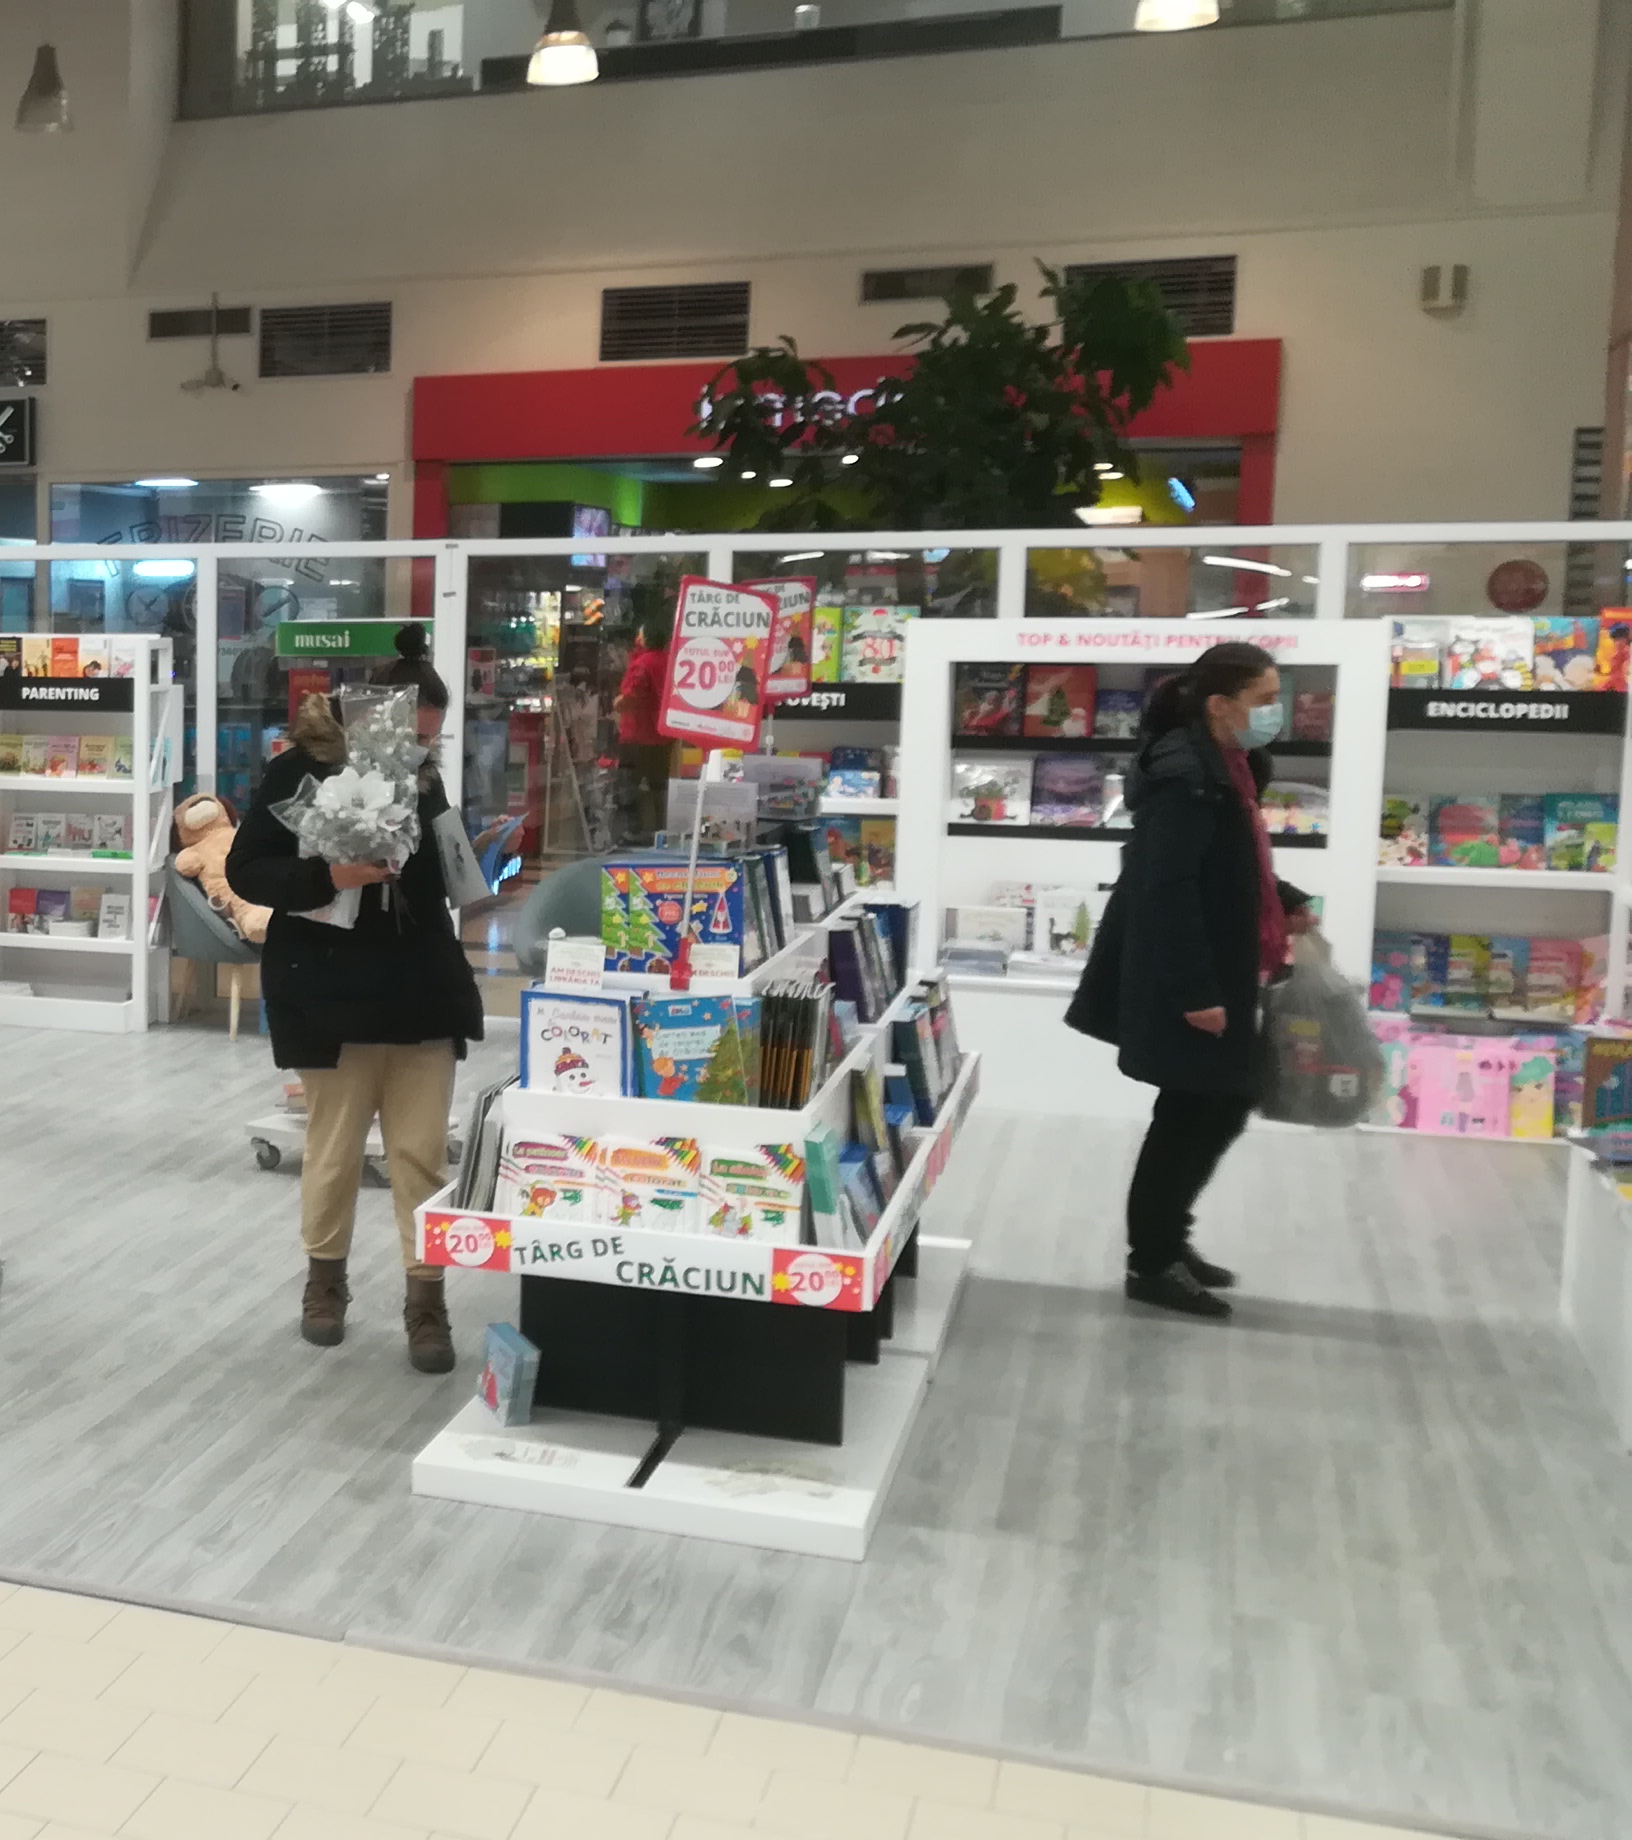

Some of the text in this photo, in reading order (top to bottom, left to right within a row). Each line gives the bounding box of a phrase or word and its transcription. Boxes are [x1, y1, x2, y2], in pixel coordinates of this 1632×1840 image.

[690, 590, 740, 604] TÂRG DE
[685, 606, 770, 628] CRĂCIUN
[294, 630, 350, 648] musai
[1017, 633, 1053, 646] TOP
[1058, 633, 1070, 646] &
[1076, 630, 1159, 650] NOUTĂȚI
[678, 660, 717, 690] 20
[22, 687, 100, 700] PARENTING
[776, 692, 846, 711] OVEȘTI
[1427, 701, 1570, 719] ENCICLOPEDII
[541, 1026, 612, 1044] COLORAT
[448, 1234, 478, 1253] 20
[515, 1235, 625, 1266] TÂRG DE
[616, 1257, 765, 1296] CRĂCIUN
[790, 1271, 824, 1291] 20
